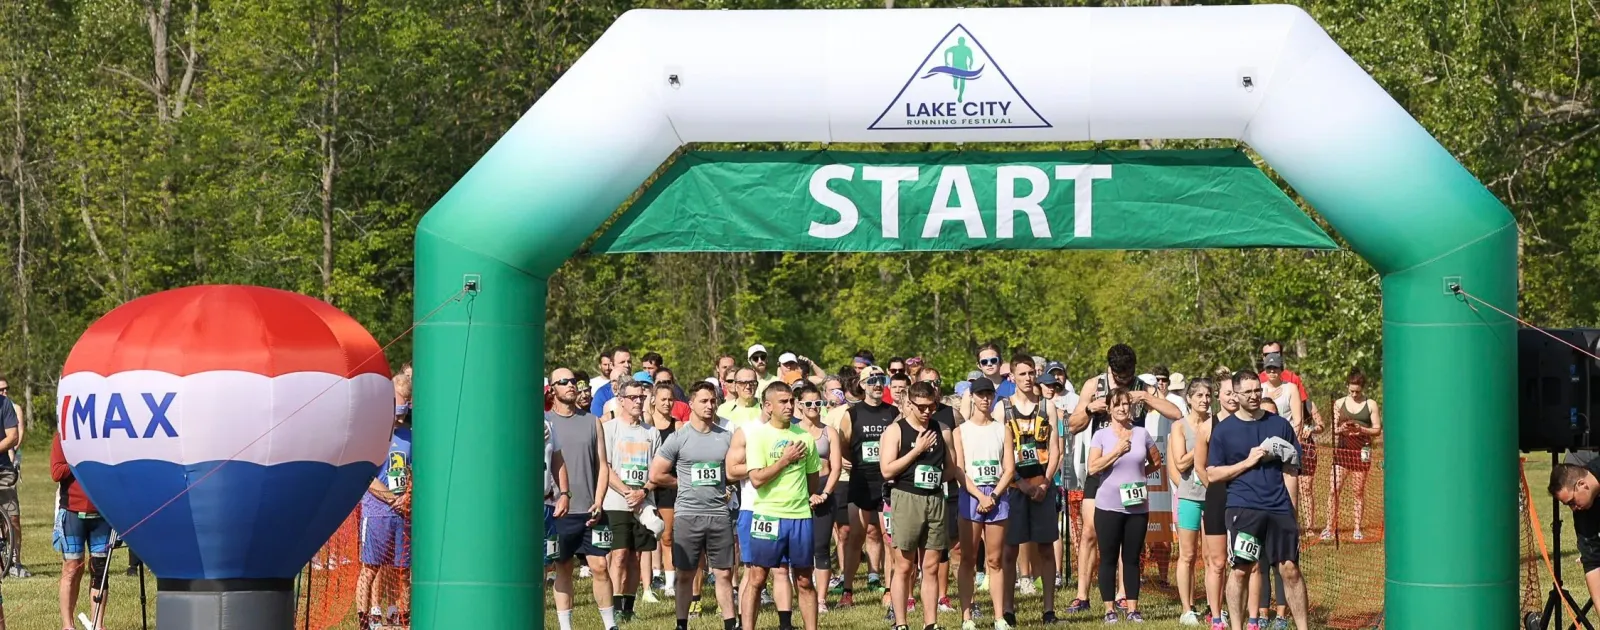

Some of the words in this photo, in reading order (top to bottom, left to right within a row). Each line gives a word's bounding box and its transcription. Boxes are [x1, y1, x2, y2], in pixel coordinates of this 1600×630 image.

[906, 102, 957, 118] LAKE
[962, 101, 1012, 116] CITY
[807, 163, 1113, 239] START
[59, 392, 180, 441] /MAX
[867, 447, 880, 457] 39
[1022, 448, 1036, 460] 98
[626, 470, 644, 481] 108
[696, 468, 717, 480] 183
[977, 466, 997, 476] 189
[394, 476, 407, 487] 18
[920, 472, 939, 483] 195
[1126, 488, 1144, 499] 191
[753, 520, 773, 533] 146
[1240, 540, 1259, 555] 105
